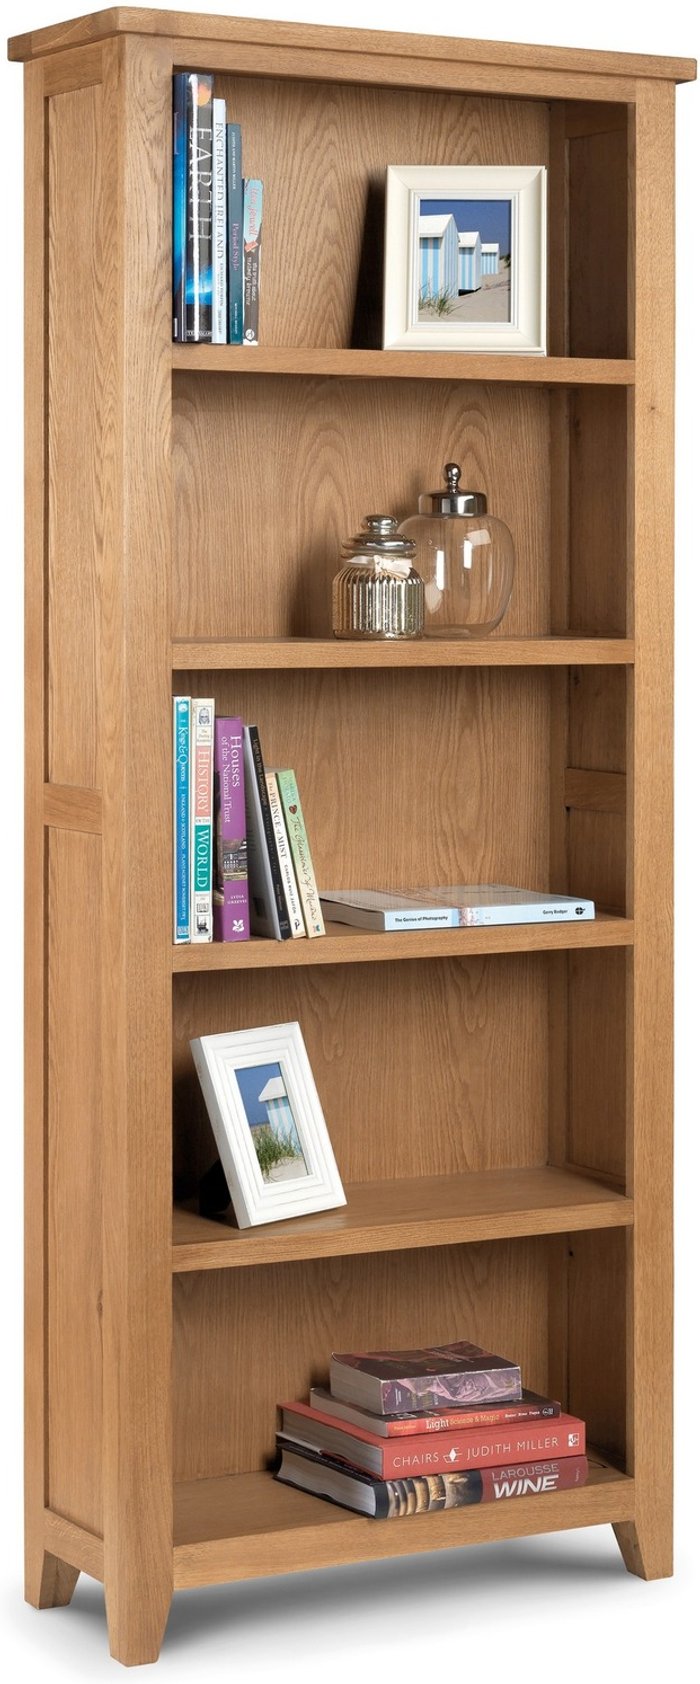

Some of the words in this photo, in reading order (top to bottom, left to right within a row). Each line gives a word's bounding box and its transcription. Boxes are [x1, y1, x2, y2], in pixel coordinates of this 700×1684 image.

[215, 122, 225, 201] ENCHANTED
[188, 126, 213, 240] EARTH
[216, 204, 225, 260] IRELAND
[232, 223, 240, 249] Period
[231, 250, 240, 271] Style
[221, 736, 230, 746] of
[222, 747, 231, 761] the
[230, 735, 242, 788] Houses
[252, 738, 261, 755] Light
[259, 774, 268, 806] Landscape
[197, 750, 210, 813] HISTORY
[223, 763, 232, 800] National
[224, 802, 232, 823] Trust
[269, 792, 282, 828] PRINCE
[277, 836, 288, 859] MIST
[197, 829, 210, 888] WORLD
[425, 1418, 449, 1431] Light
[393, 1452, 440, 1468] CHAIRS
[466, 1443, 511, 1461] JUDITH
[517, 1437, 559, 1452] MILLER
[491, 1463, 560, 1481] LAROUSSE
[493, 1474, 560, 1499] WINE
